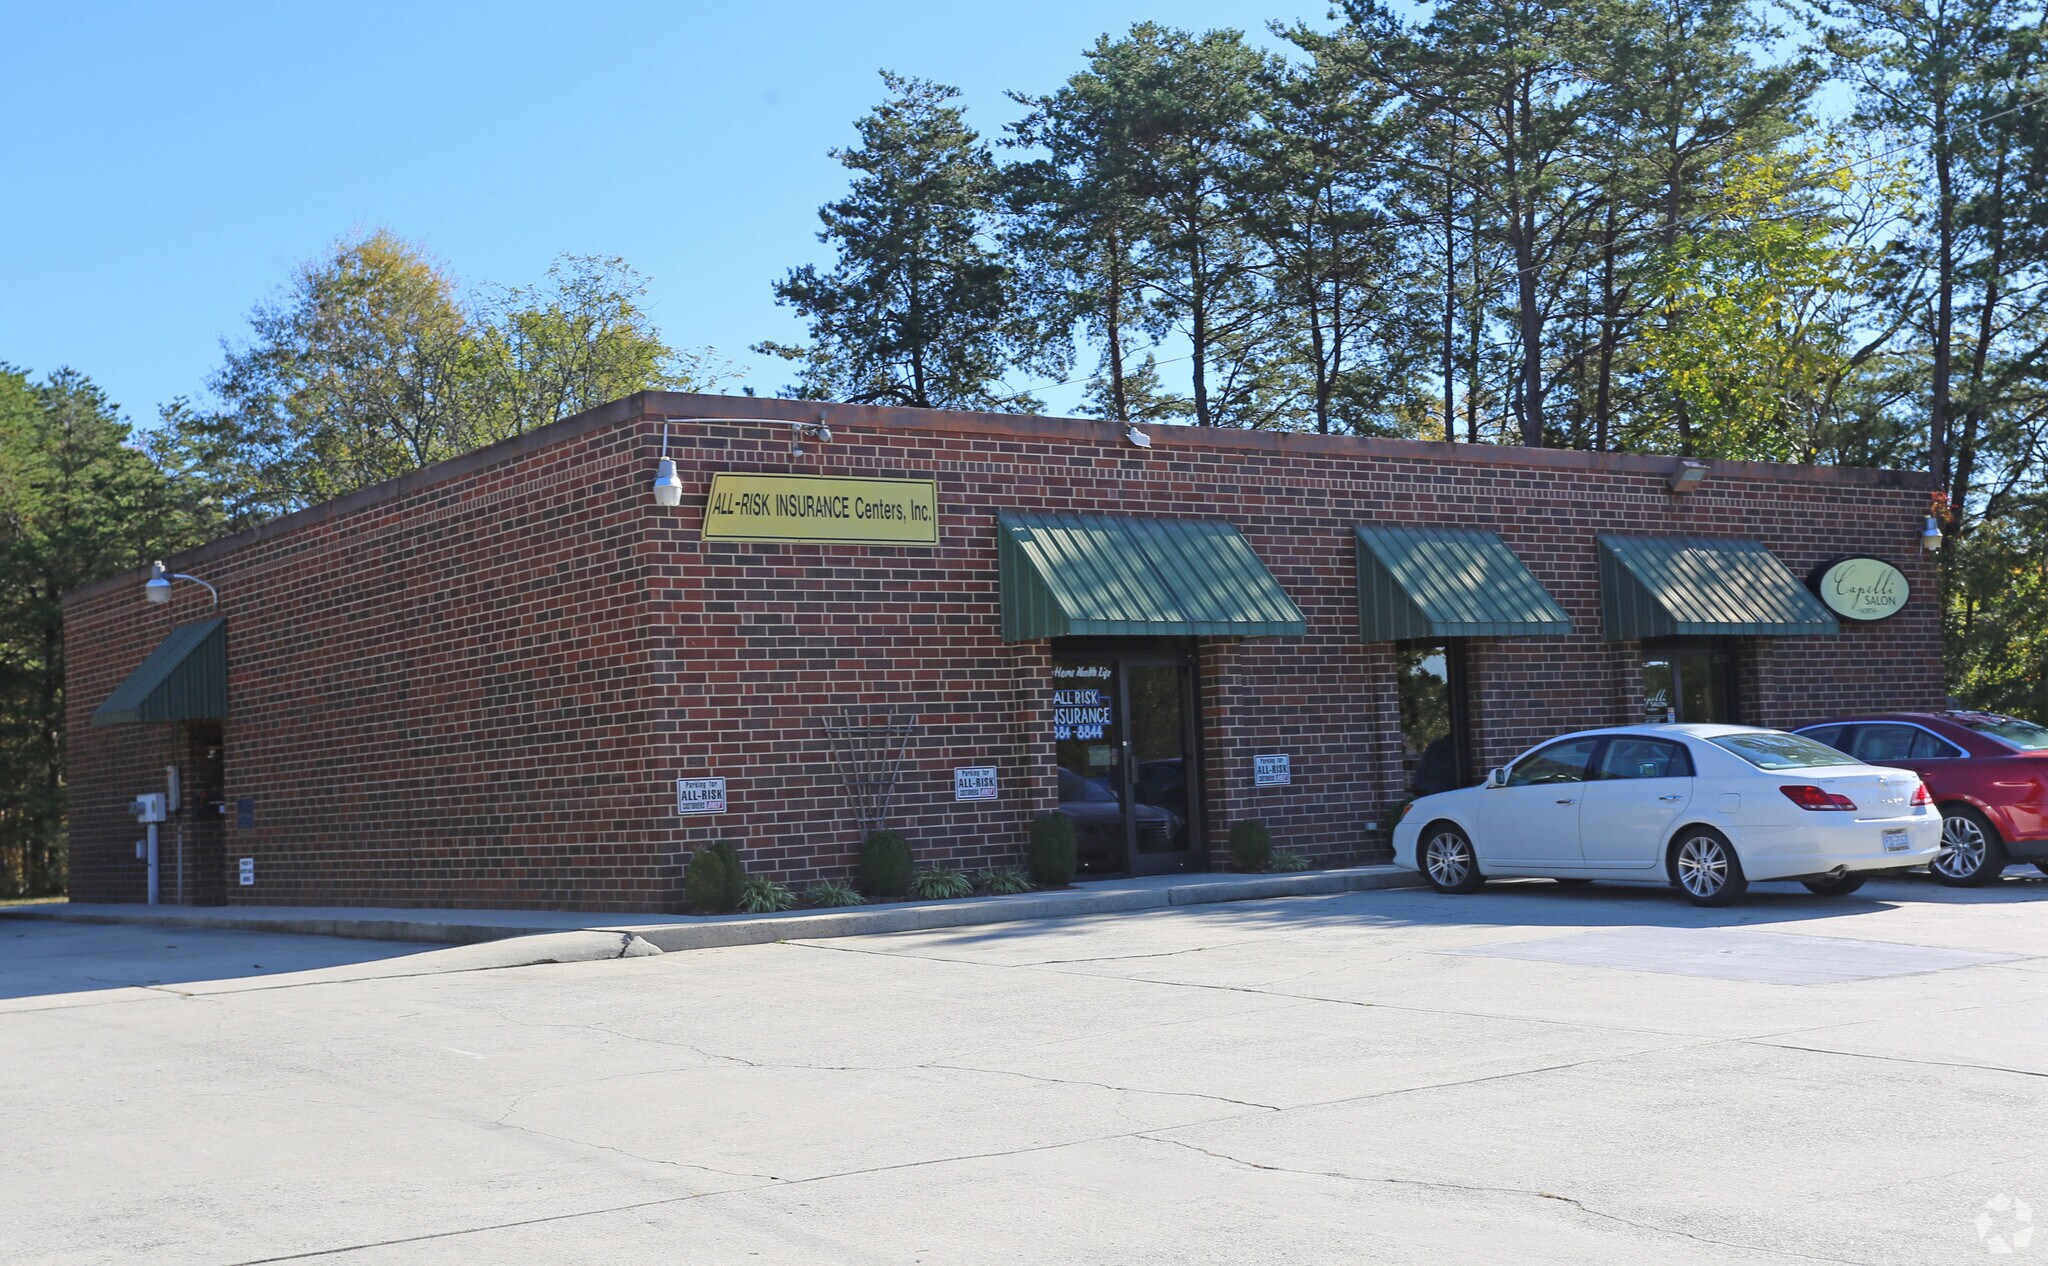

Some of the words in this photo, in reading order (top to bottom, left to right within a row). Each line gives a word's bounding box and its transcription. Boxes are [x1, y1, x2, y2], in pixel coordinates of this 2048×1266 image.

[712, 492, 771, 516] ALL-RISK
[776, 494, 850, 518] INSURANCE
[855, 496, 907, 524] Centers,
[911, 499, 932, 521] Inc.
[1833, 564, 1896, 609] Capelli
[1865, 595, 1896, 606] SALON
[1054, 666, 1075, 678] Home
[1054, 691, 1073, 705] ALL
[1074, 691, 1098, 704] RISK
[1258, 764, 1288, 774] ALL-RISK
[685, 781, 706, 789] Parking
[959, 777, 994, 788] ALL-RISK
[682, 789, 723, 801] ALL-RISK
